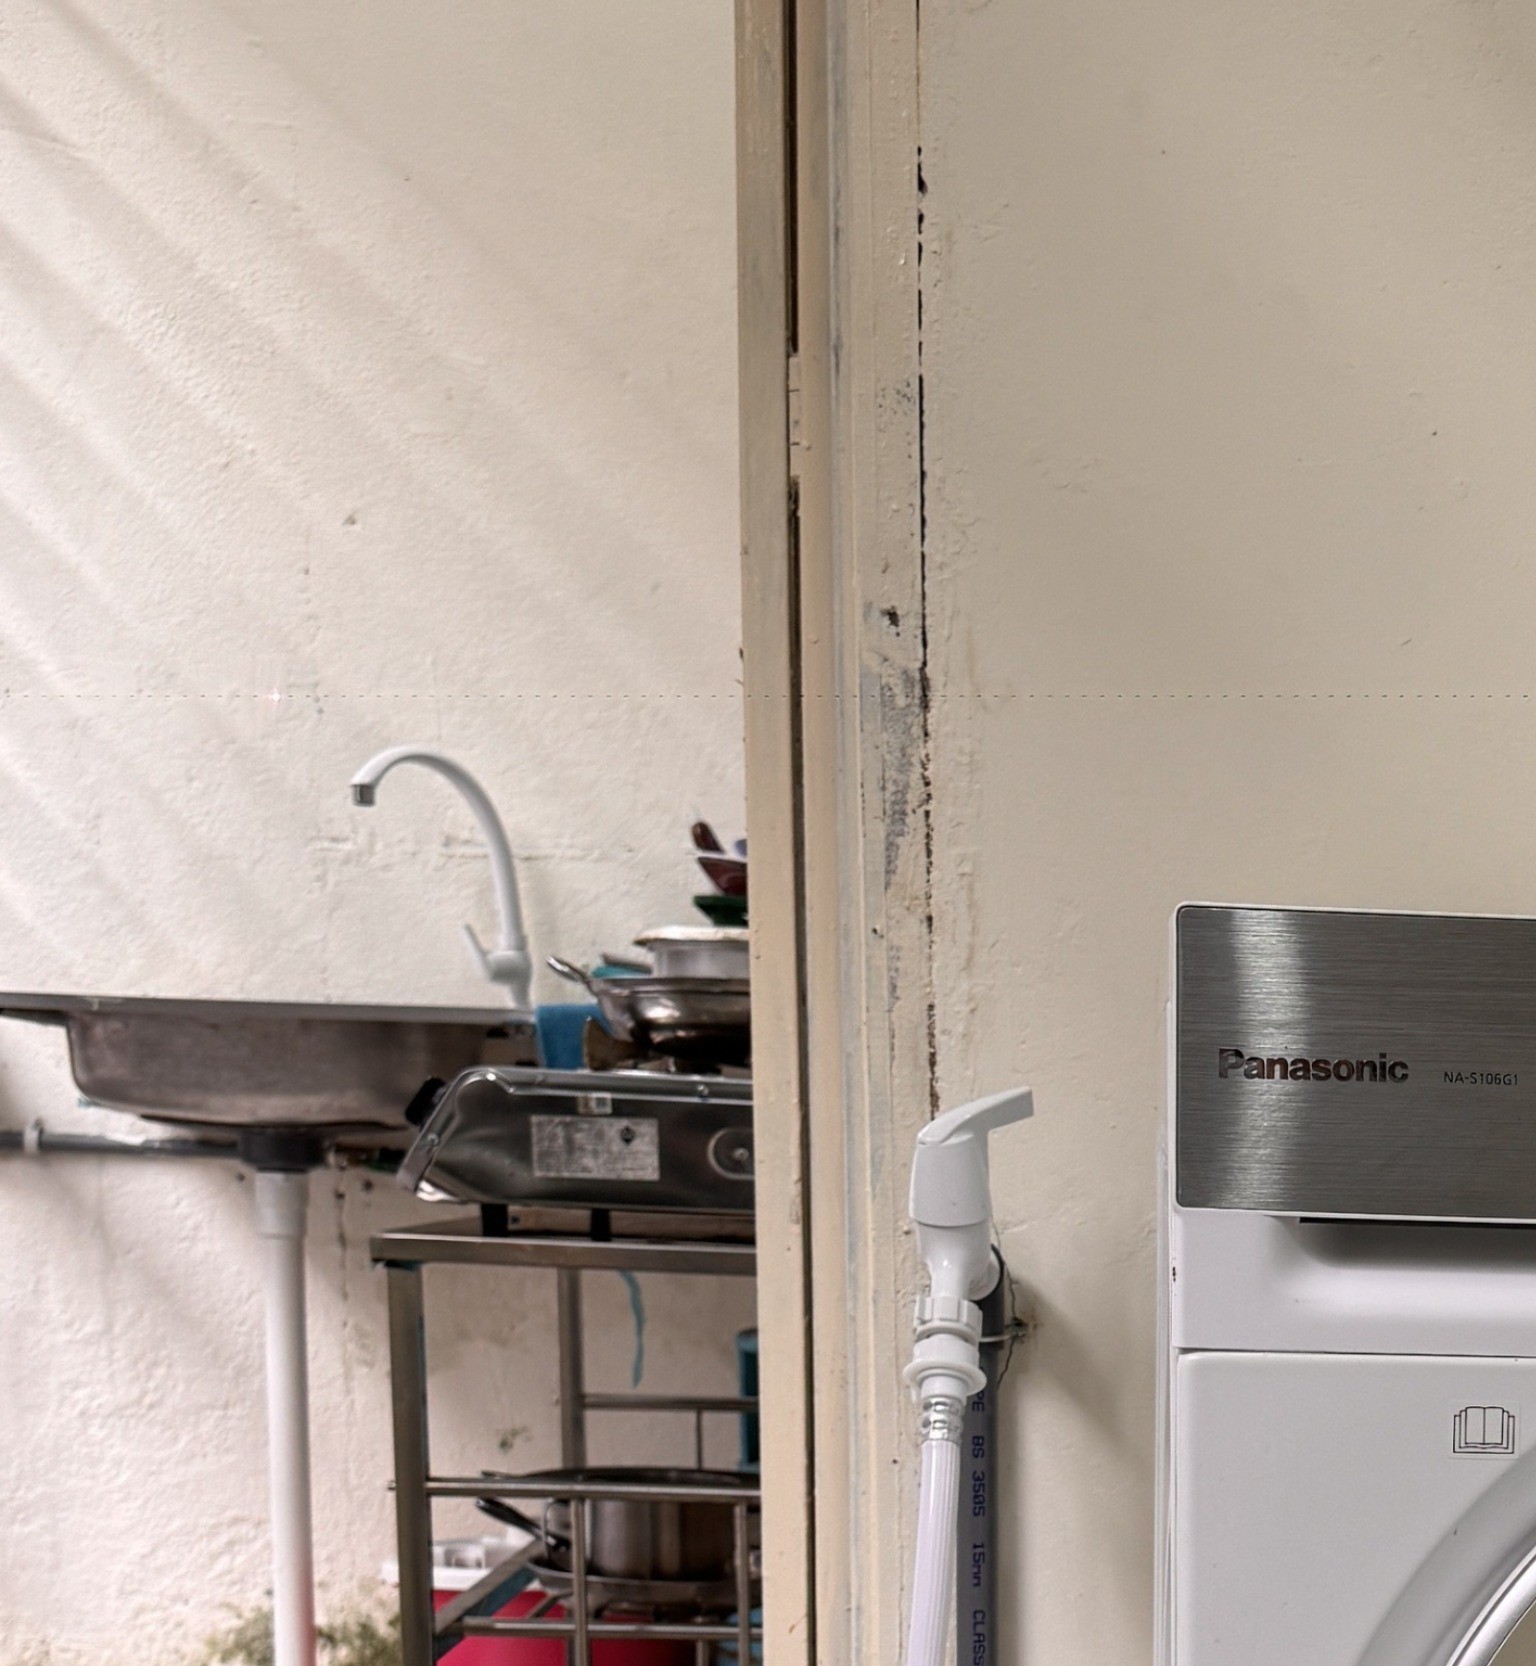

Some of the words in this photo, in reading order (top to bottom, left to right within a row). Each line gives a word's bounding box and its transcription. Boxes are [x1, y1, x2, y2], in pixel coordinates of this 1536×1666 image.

[1218, 1048, 1410, 1084] Panasonic
[1443, 1070, 1520, 1087] NA-S106G1
[972, 1435, 985, 1458] BS
[973, 1470, 986, 1518] 3505
[973, 1609, 986, 1666] CLASS
